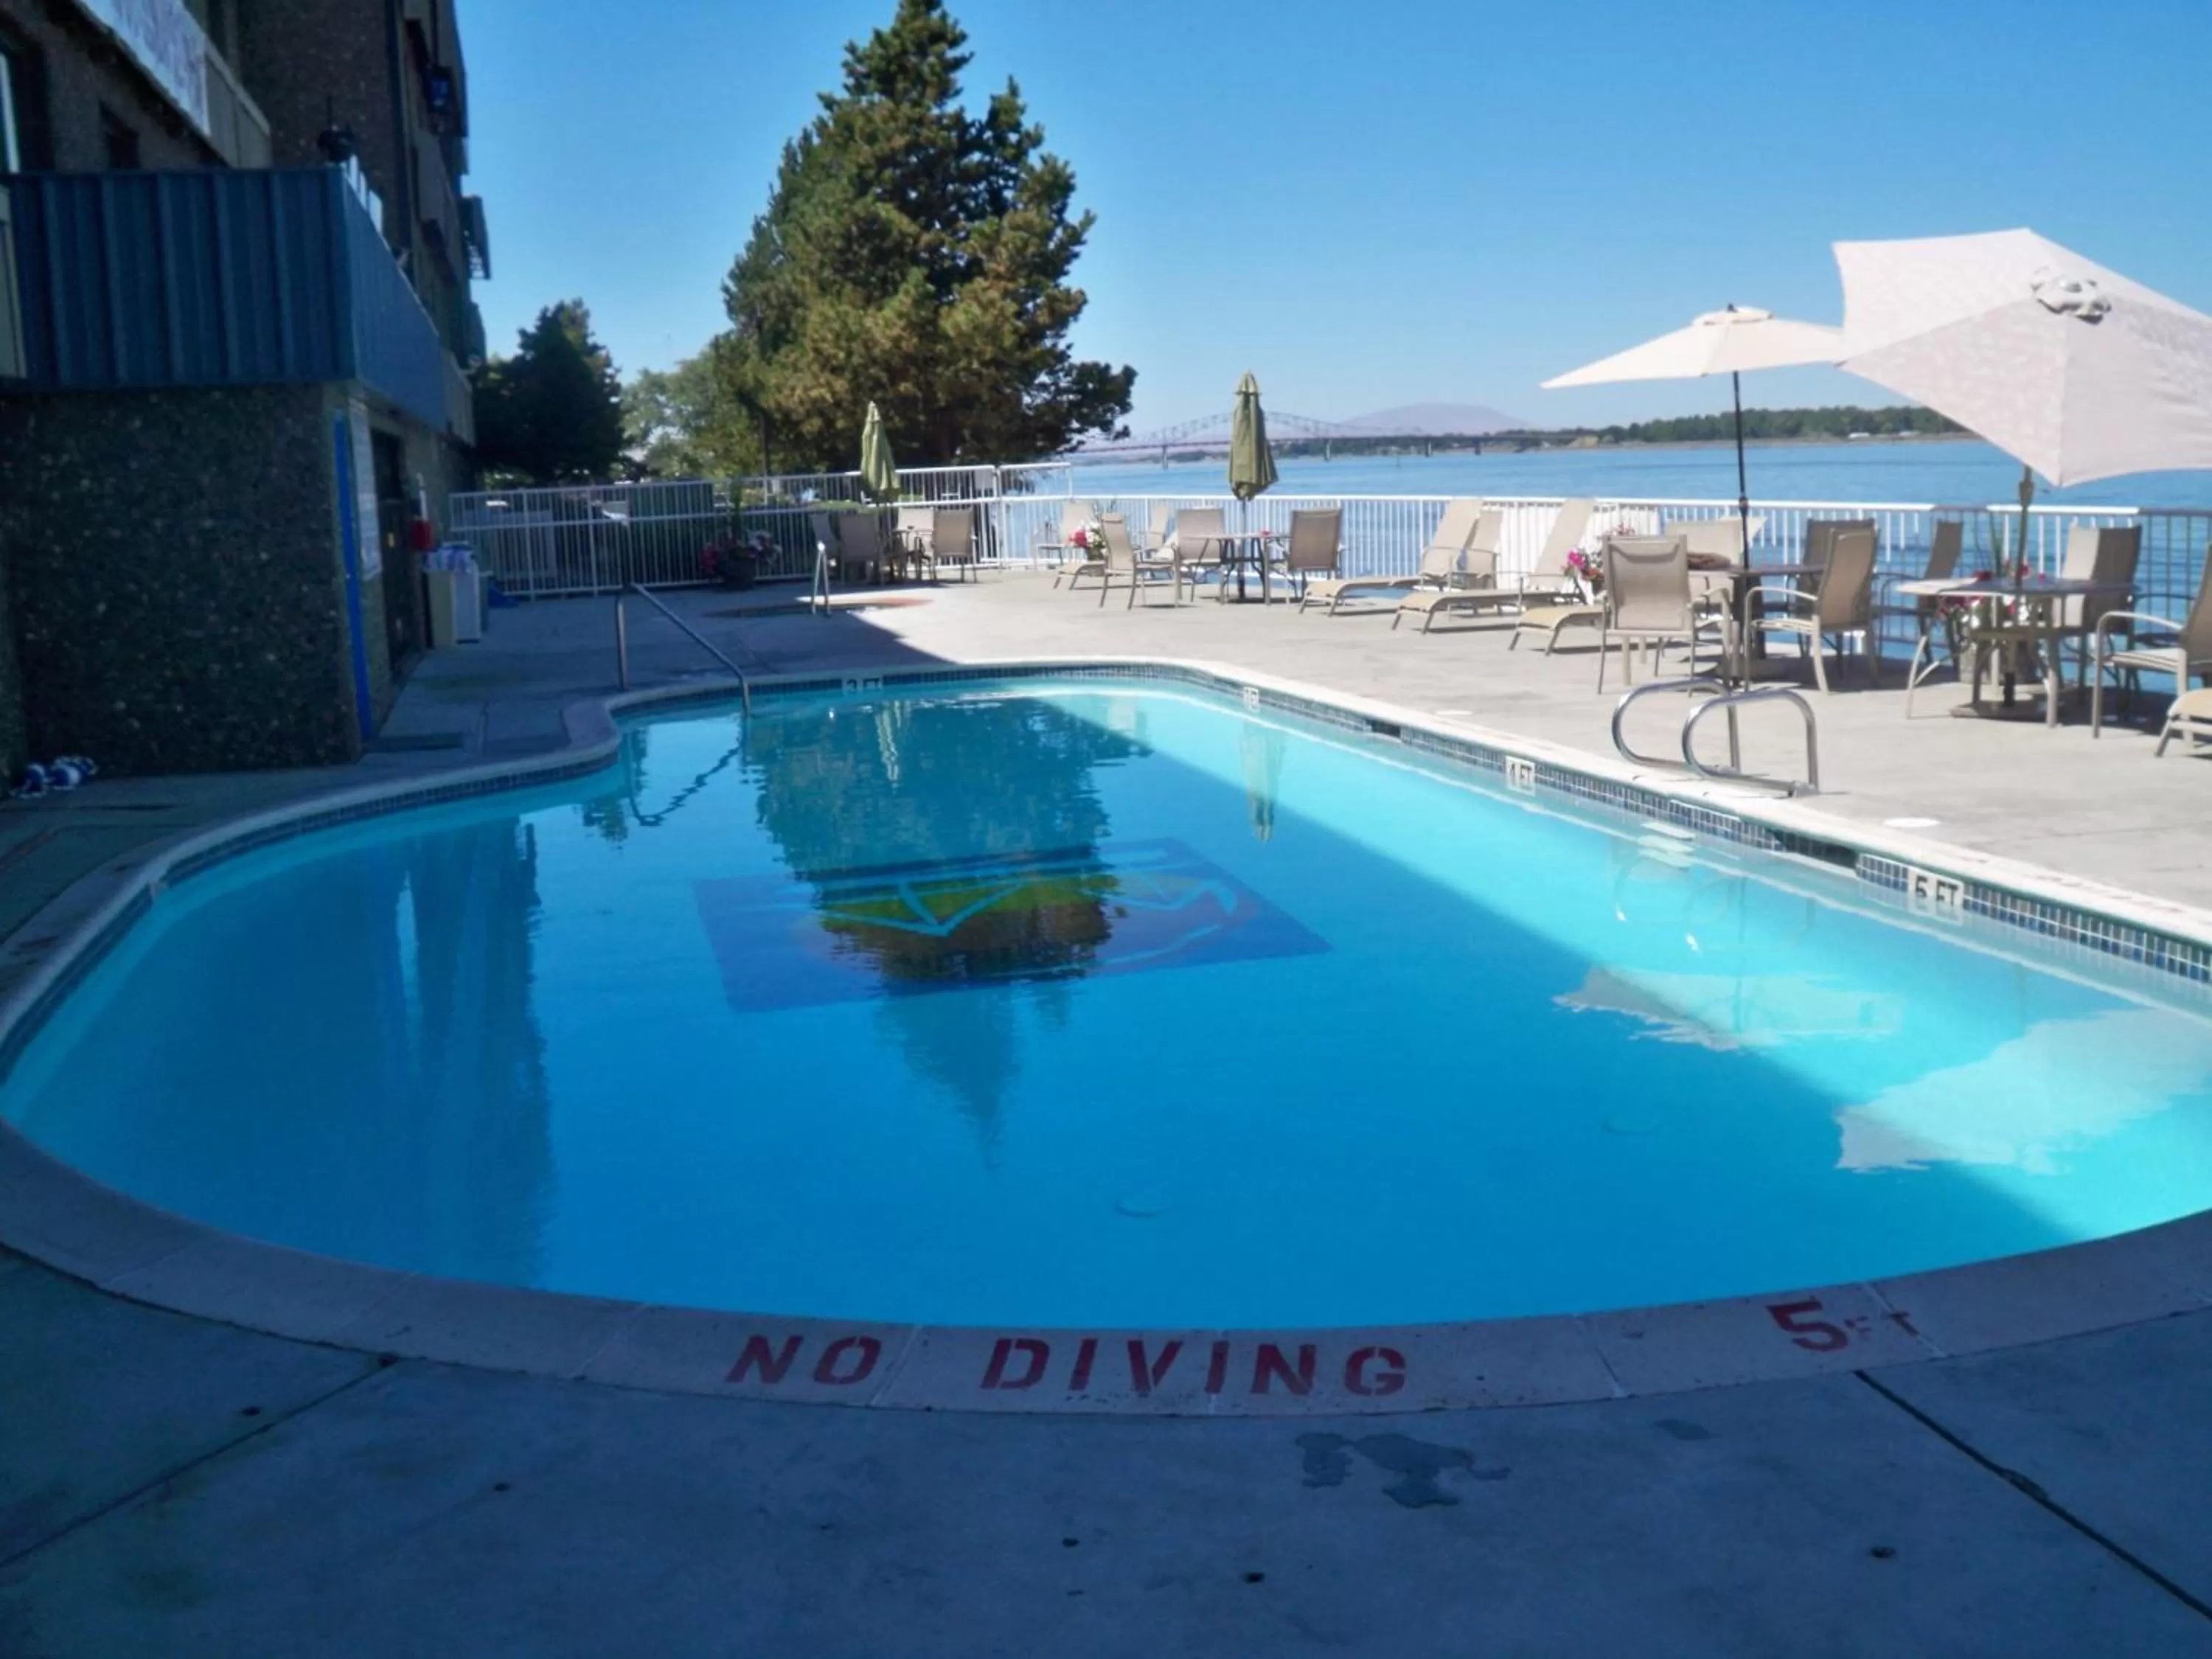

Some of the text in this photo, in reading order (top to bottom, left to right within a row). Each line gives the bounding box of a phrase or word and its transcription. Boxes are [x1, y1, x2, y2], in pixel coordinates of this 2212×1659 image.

[1935, 880, 1959, 907] FT
[1765, 1300, 1848, 1352] 5
[724, 1335, 1406, 1397] NO DIVING
